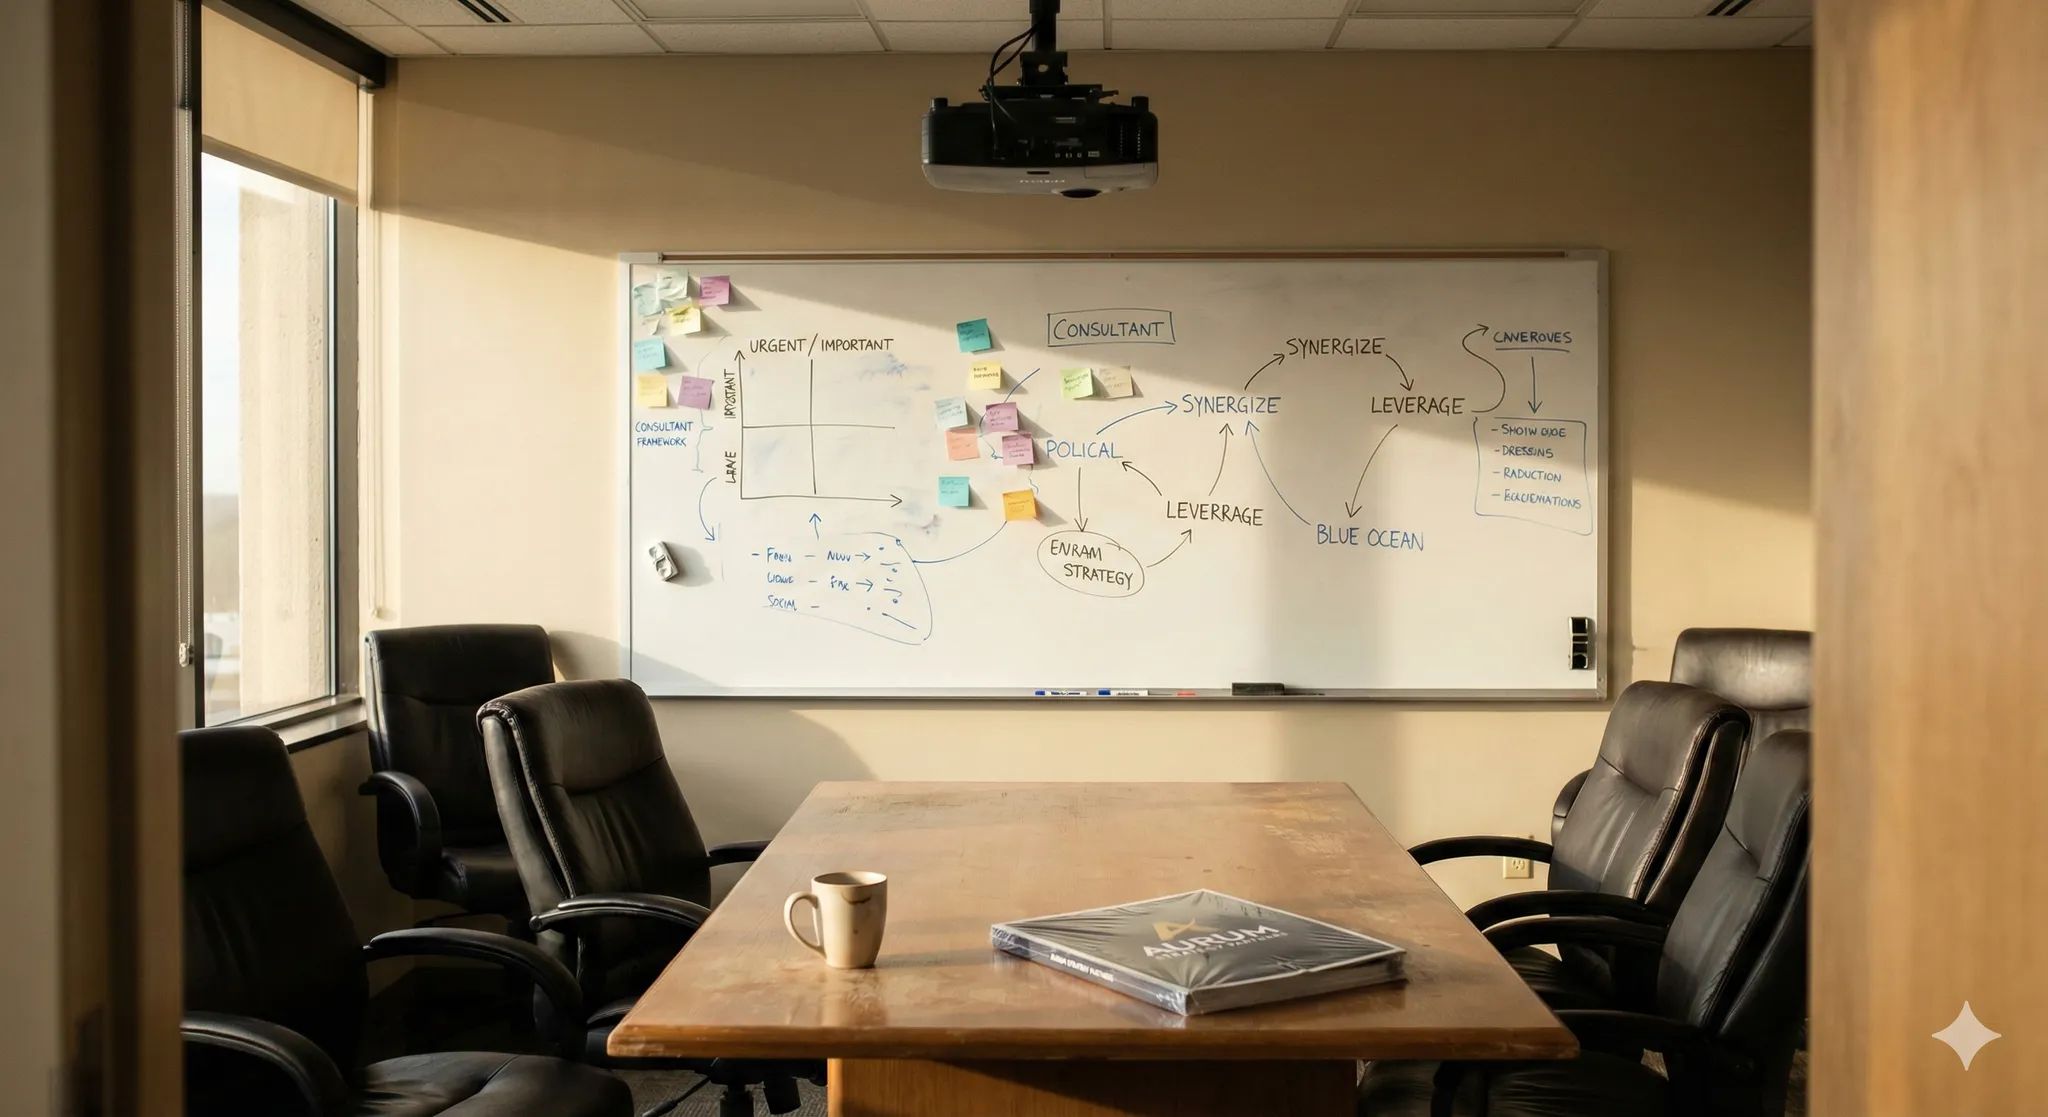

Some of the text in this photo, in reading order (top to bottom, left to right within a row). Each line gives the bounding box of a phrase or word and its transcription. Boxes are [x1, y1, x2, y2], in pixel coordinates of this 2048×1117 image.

[1053, 319, 1165, 340] CONSULTANT
[1286, 337, 1386, 360] SYNERGIZE
[1182, 394, 1282, 417] SYNERGIZE
[1371, 397, 1466, 416] LEVERAGE
[635, 421, 694, 432] CONSULTANT
[637, 437, 687, 447] FRAMEWORK
[1046, 440, 1123, 459] POLICAL
[1167, 500, 1264, 526] LEVERRAGE
[1317, 524, 1424, 551] BLUE OCEAN
[1063, 563, 1134, 591] STRATEGY
[1143, 924, 1280, 957] AURUM
